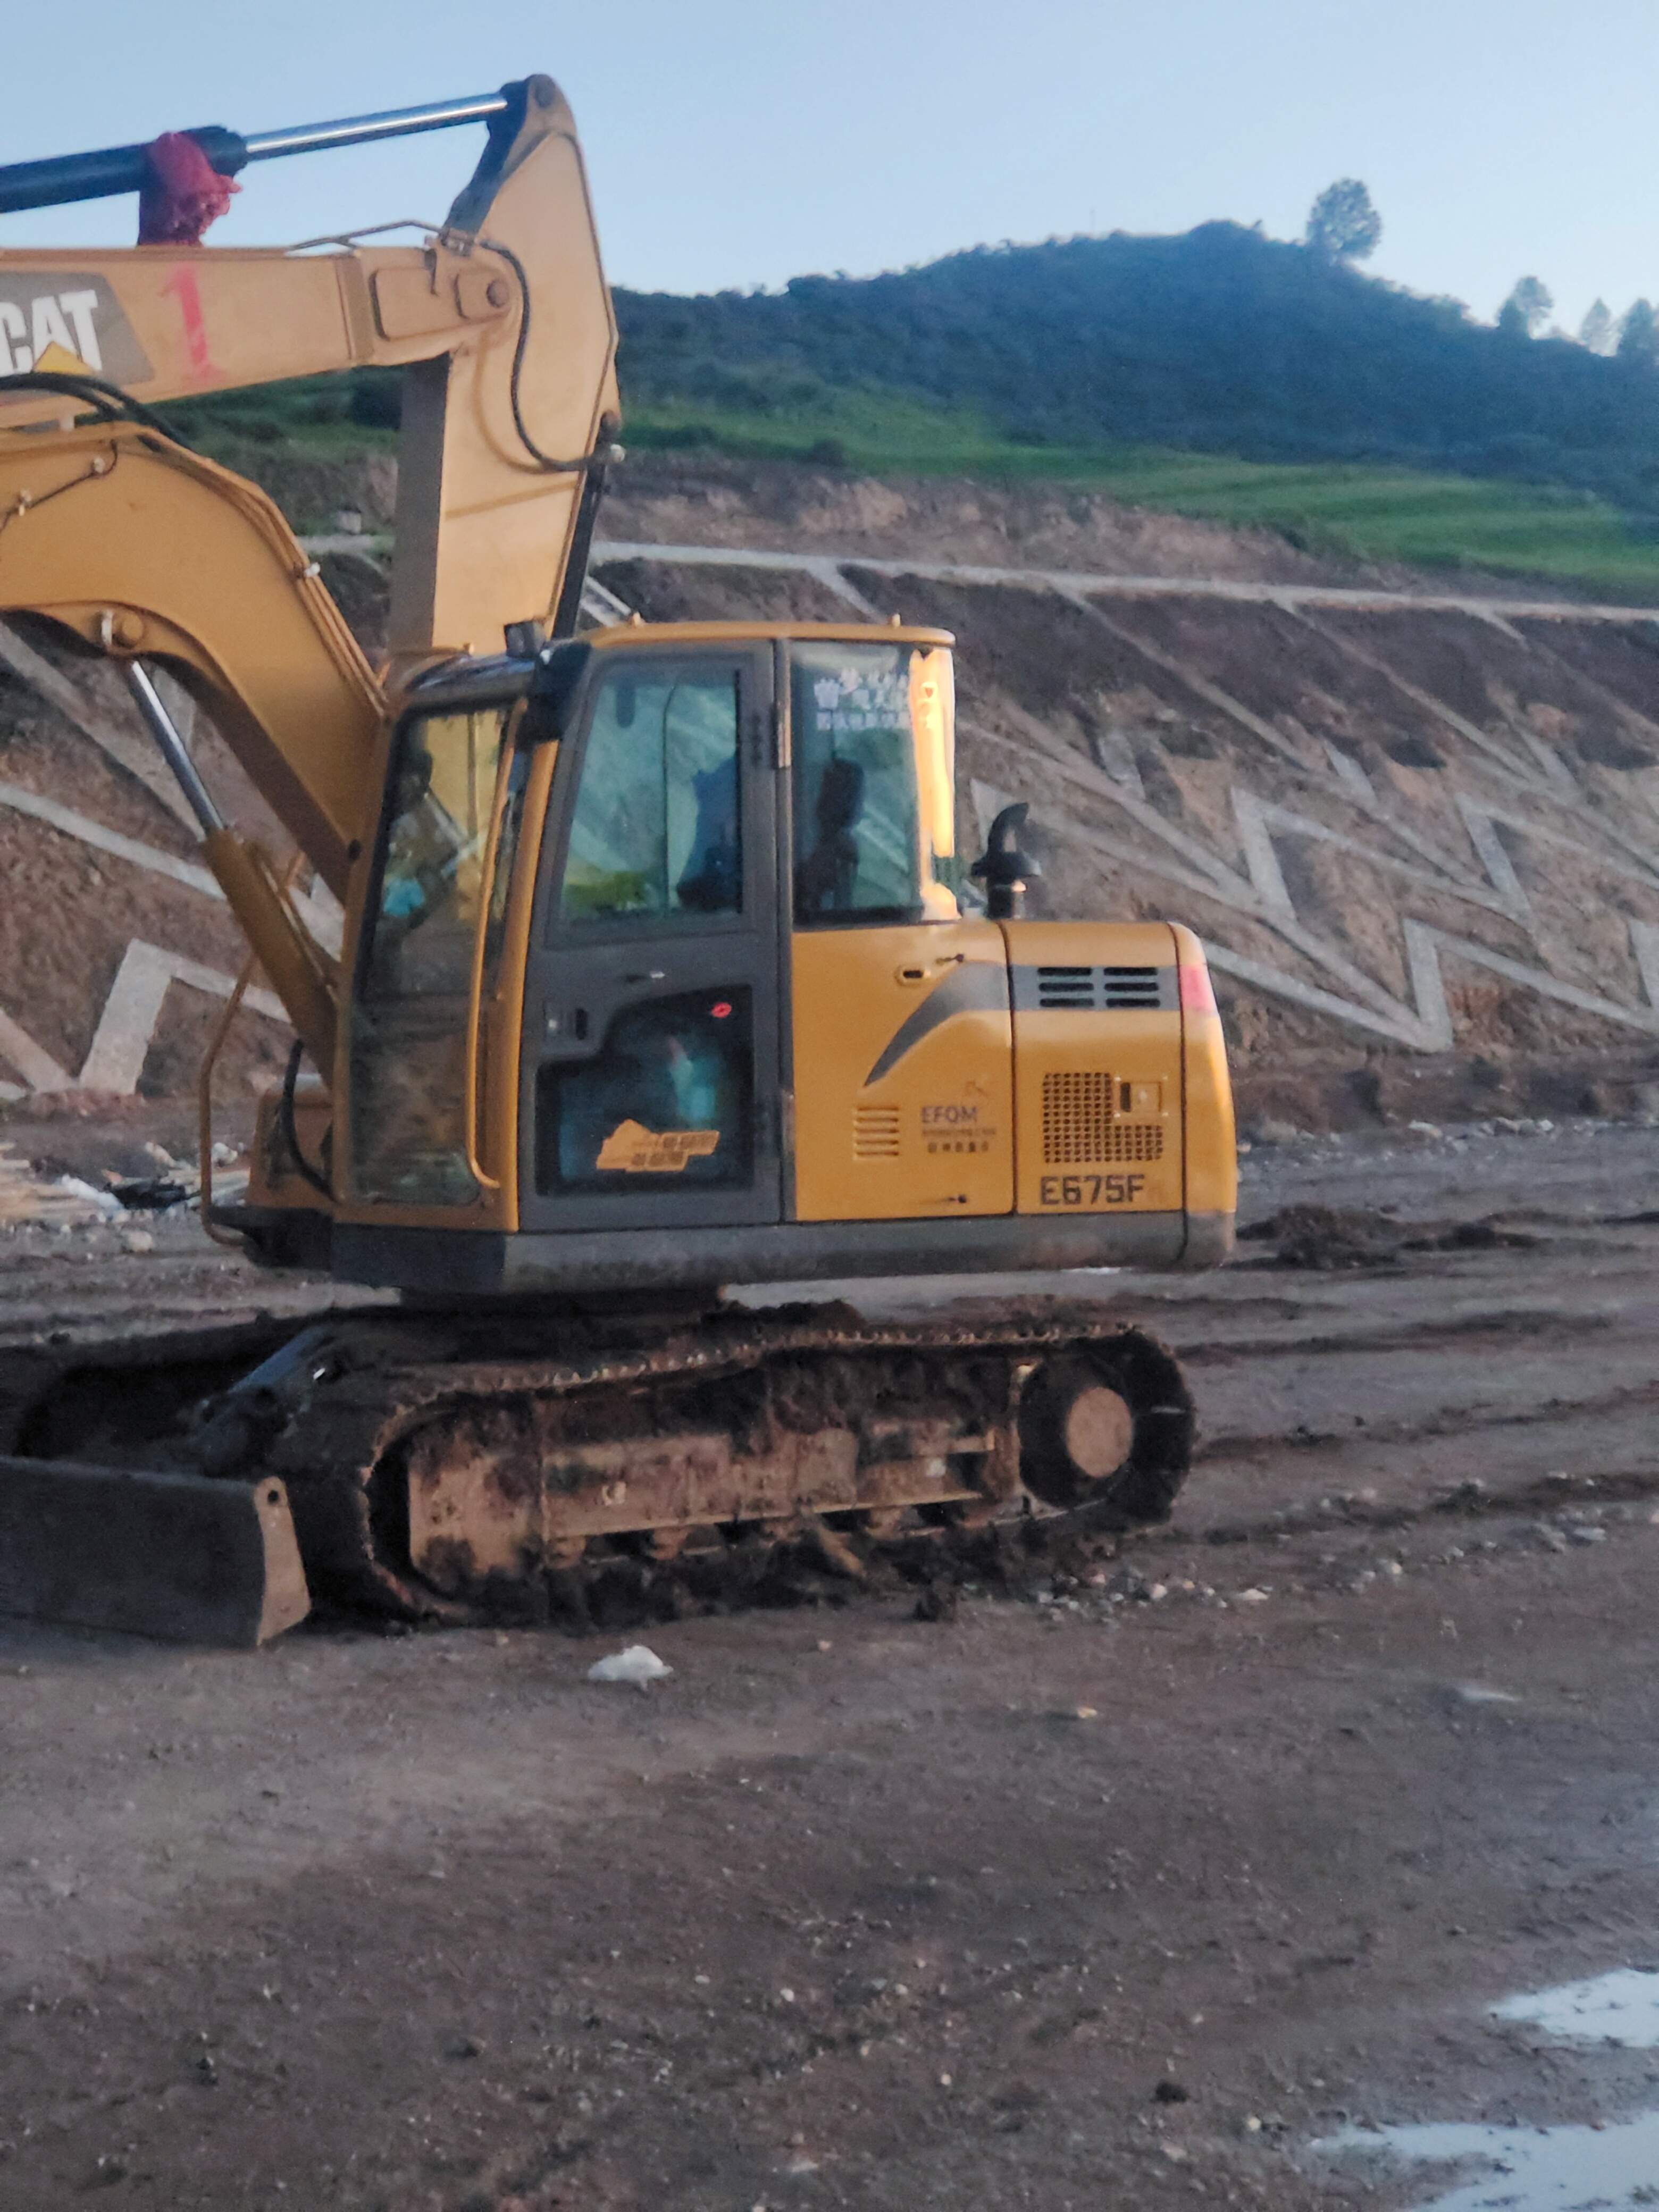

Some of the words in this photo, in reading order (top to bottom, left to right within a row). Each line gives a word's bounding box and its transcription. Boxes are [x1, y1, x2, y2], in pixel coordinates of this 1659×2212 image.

[0, 289, 103, 377] CAT
[158, 262, 227, 388] 1
[1041, 1174, 1145, 1205] E675F
